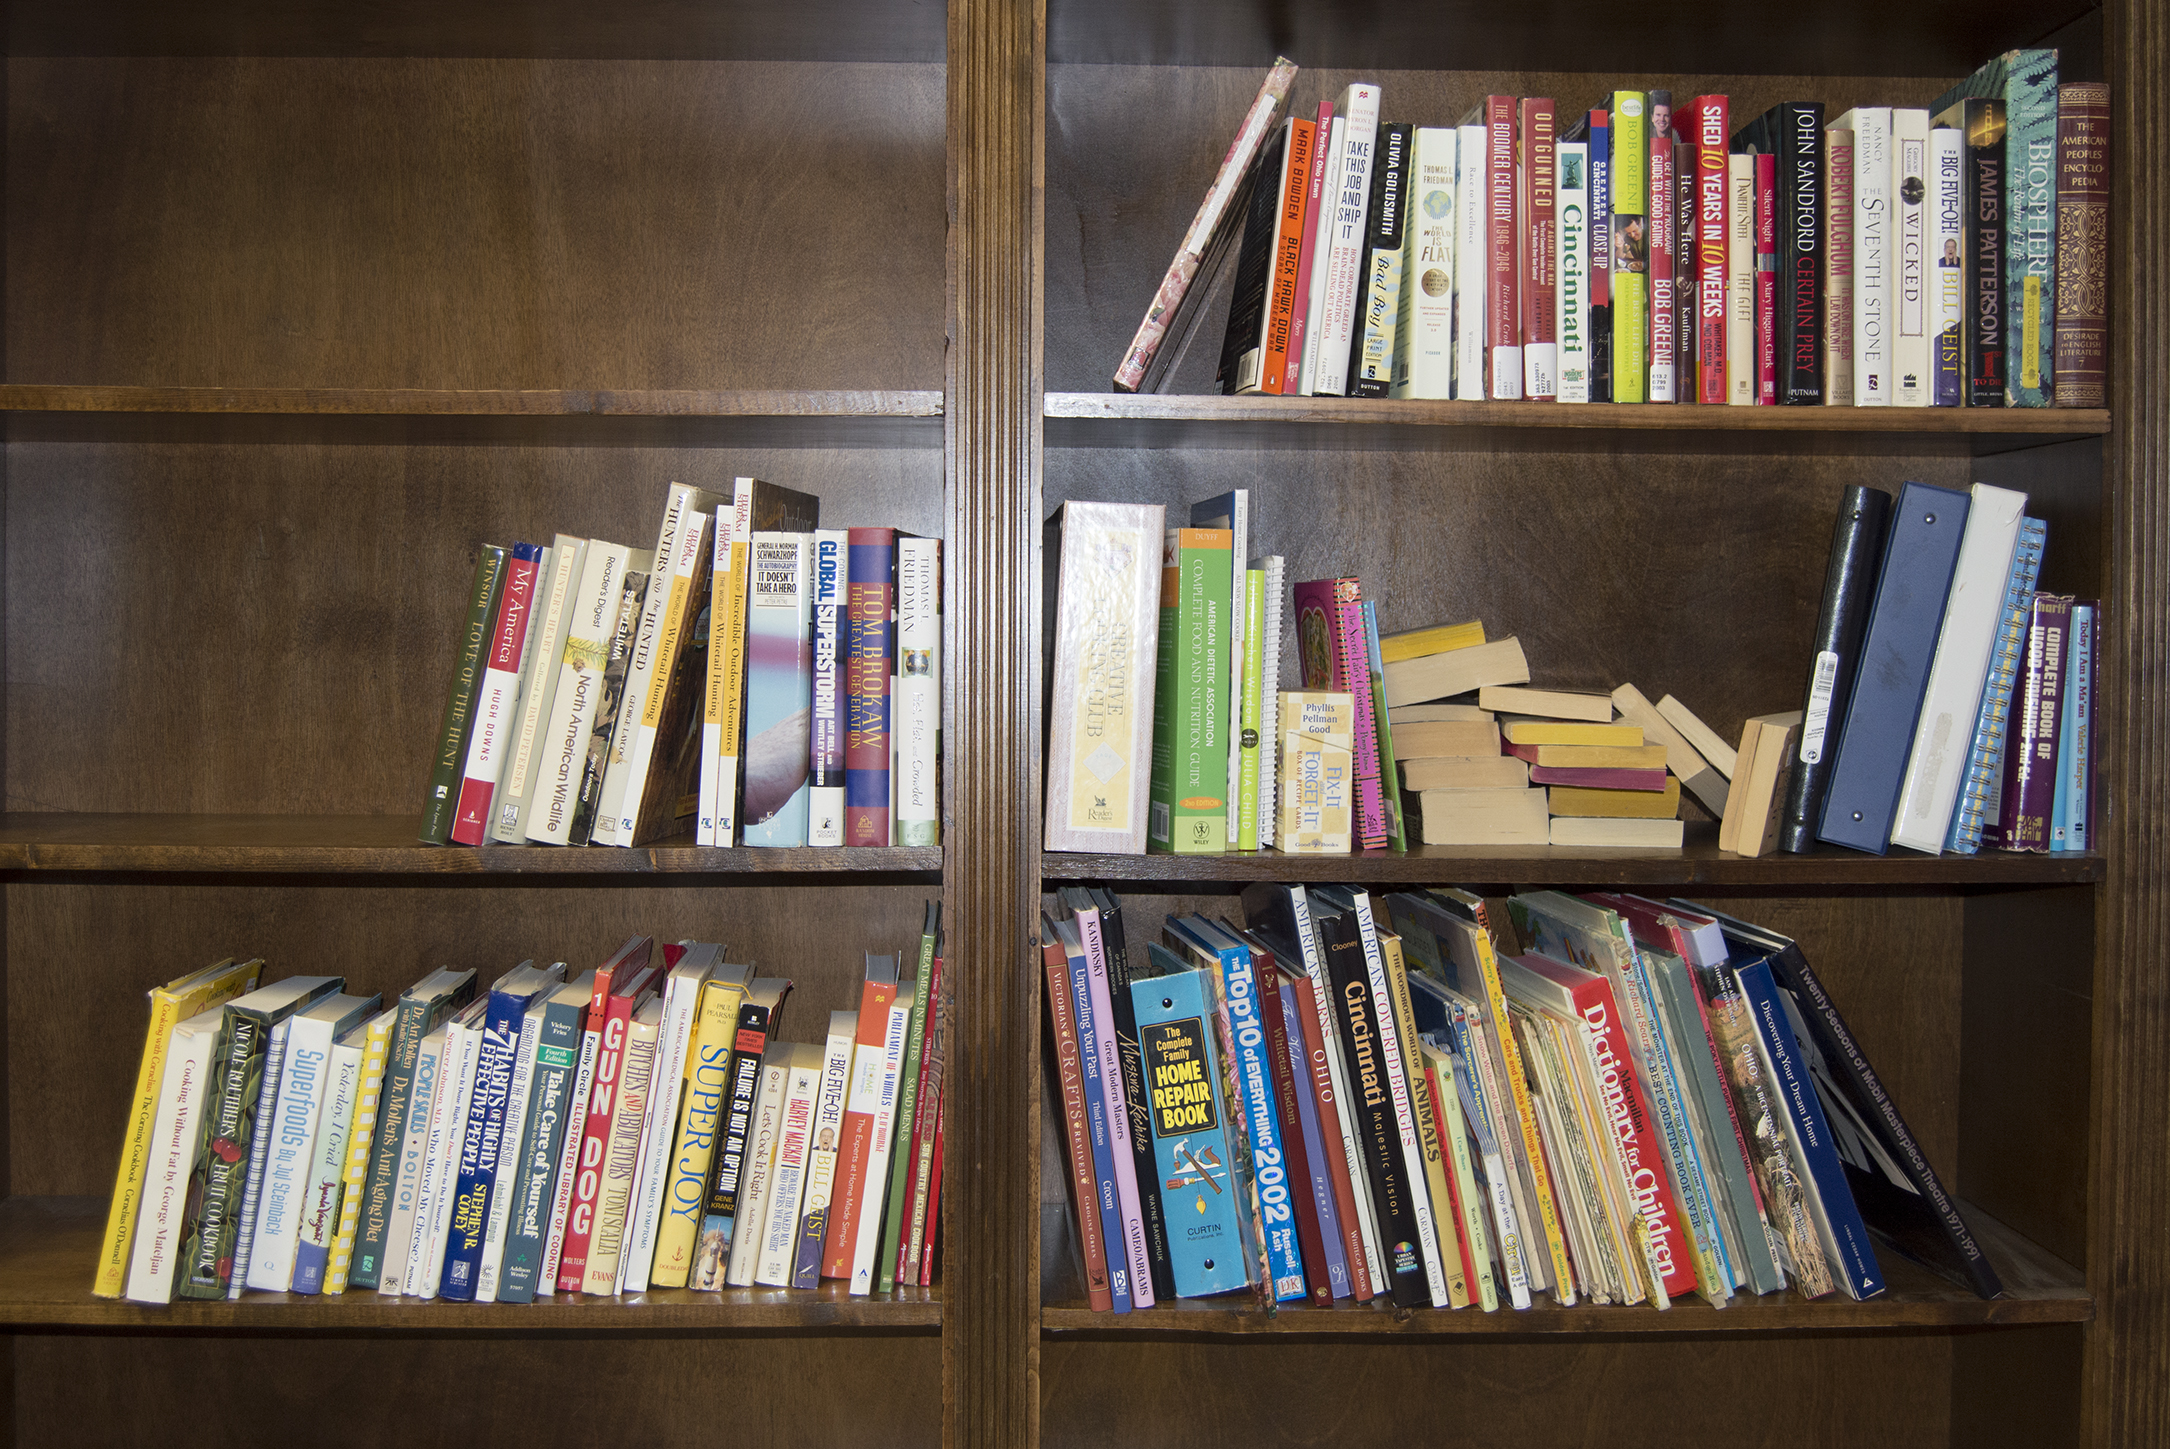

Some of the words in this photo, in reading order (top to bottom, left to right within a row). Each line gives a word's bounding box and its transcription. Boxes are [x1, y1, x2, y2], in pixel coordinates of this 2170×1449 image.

[1321, 116, 1329, 130] The
[1495, 104, 1508, 119] THE
[1703, 106, 1721, 145] SHED
[2077, 123, 2094, 131] THE
[1295, 128, 1308, 164] MARK
[1318, 131, 1328, 158] Perfect
[1346, 141, 1369, 156] TAKE
[1494, 123, 1510, 168] BOOMER
[1793, 108, 1815, 154] JOHN
[2062, 136, 2106, 145] AMERICAN
[1315, 159, 1323, 177] Ohio
[1346, 158, 1366, 174] THIS
[1388, 133, 1401, 168] OLIVIA
[1535, 113, 1552, 207] OUTGUNNED
[1701, 147, 1724, 170] 10
[2067, 150, 2102, 159] PEOPLES
[1288, 168, 1303, 220] BOWDEN
[1312, 178, 1321, 198] Lawn
[1341, 192, 1360, 206] AND
[1344, 175, 1362, 189] JOB
[1494, 173, 1511, 222] CENTURY
[1703, 173, 1722, 221] YEARS
[1977, 159, 1998, 221] JAMES
[2072, 177, 2097, 186] PEDIA
[1338, 208, 1360, 223] SHIP
[1382, 172, 1398, 235] GOLDSMITH
[1797, 160, 1815, 251] SANDFORD
[1342, 225, 1352, 239] IT
[1703, 226, 1721, 240] IN
[1284, 237, 1297, 275] BLACK
[1701, 242, 1725, 264] 10
[1905, 212, 1919, 302] WICKED
[1375, 257, 1389, 291] Bad
[1563, 204, 1583, 354] Cincinnati
[1703, 266, 1722, 318] WEEKS
[1797, 257, 1814, 327] CERTAIN
[1980, 228, 1998, 346] PATTERSON
[1279, 280, 1293, 314] HAWK
[1369, 295, 1385, 328] Boy
[1275, 319, 1288, 353] DOWN
[1797, 335, 1814, 373] PREY
[478, 559, 496, 608] WINSOR
[511, 568, 532, 595] My
[756, 583, 772, 593] TAKE
[773, 583, 778, 592] A
[779, 583, 796, 593] HERO
[758, 572, 765, 581] IT
[766, 572, 794, 582] DOESN'T
[818, 540, 837, 601] GLOBAL
[1193, 559, 1204, 619] COMPLETE
[863, 585, 883, 636] TOM
[1207, 600, 1216, 645] AMERICAN
[466, 622, 483, 662] LOVE
[499, 598, 524, 662] America
[1192, 621, 1203, 655] FOOD
[461, 668, 473, 688] OF
[816, 605, 837, 718] SUPERSTORM
[1191, 658, 1202, 684] AND
[1206, 648, 1216, 684] DIETETIC
[452, 693, 469, 722] THE
[572, 674, 591, 712] North
[862, 646, 884, 749] BROKAW
[1306, 704, 1335, 712] Phyllis
[1190, 688, 1200, 749] NUTRITION
[1206, 688, 1214, 746] ASSOCIATION
[1303, 715, 1337, 723] Pellman
[1309, 725, 1330, 734] Good
[442, 727, 461, 770] HUNT
[557, 714, 582, 782] American
[1189, 753, 1199, 787] GUIDE
[547, 783, 568, 832] Wildlife
[1087, 921, 1103, 978] KANDINSKY
[1232, 957, 1240, 971] THE
[1229, 964, 1252, 1016] Top
[484, 1028, 519, 1050] 7
[499, 1020, 509, 1035] THE
[1156, 1037, 1192, 1051] Complete
[1165, 1027, 1181, 1038] The
[1237, 1015, 1262, 1047] 10
[1357, 904, 1384, 987] AMERICAN
[1375, 992, 1400, 1070] COVERED
[1390, 1074, 1415, 1146] BRIDGES
[582, 1036, 595, 1066] Family
[1164, 1049, 1190, 1062] Family
[1243, 1048, 1259, 1061] of
[1344, 981, 1386, 1108] Cincinnati
[471, 1043, 496, 1119] EFFECTIVE
[488, 1046, 514, 1108] HABITS
[578, 1068, 590, 1096] Circle
[592, 1018, 624, 1116] GUN
[624, 1038, 655, 1091] BITCHES
[735, 1059, 756, 1098] FAILURE
[829, 1058, 846, 1076] BIG
[1155, 1060, 1202, 1087] HOME
[1583, 1001, 1637, 1149] Dictionary
[1761, 1000, 1785, 1059] Discovering
[1781, 1056, 1795, 1086] Your
[1791, 1081, 1807, 1119] Dream
[1803, 1117, 1819, 1148] Home
[281, 1049, 324, 1146] Superfoods
[545, 1070, 564, 1108] Take
[624, 1091, 642, 1111] AND
[683, 1044, 729, 1150] SUPER
[734, 1100, 750, 1111] IS
[822, 1078, 842, 1124] FIVE-OH!
[1154, 1082, 1211, 1108] REPAIR
[1246, 1063, 1273, 1148] EVERYTHING
[492, 1109, 502, 1122] OF
[538, 1110, 557, 1149] Care
[731, 1113, 747, 1135] NOT
[1162, 1103, 1209, 1129] BOOK
[1414, 1077, 1440, 1162] ANIMALS
[1799, 964, 1827, 1011] Twenty
[1826, 1009, 1857, 1060] Seasons
[1853, 1055, 1866, 1071] of
[1861, 1071, 1886, 1103] Mobil
[1880, 1102, 1925, 1171] Masterpiece
[1921, 1169, 1950, 1213] Theatre
[1946, 1210, 1981, 1261] 1971-1991
[461, 1120, 482, 1176] PEOPLE
[479, 1121, 501, 1173] HIGHLY
[565, 1102, 584, 1169] ILLUSTRATED
[608, 1108, 642, 1180] ABDICATORS
[726, 1137, 743, 1152] AN
[422, 1157, 435, 1193] Moved
[535, 1152, 550, 1170] of
[720, 1154, 740, 1192] OPTION
[813, 1153, 831, 1189] BILL
[1627, 1148, 1640, 1167] for
[211, 1164, 230, 1199] FRUIT
[557, 1173, 572, 1215] LIBRARY
[573, 1136, 603, 1235] DOG
[671, 1158, 706, 1226] JOY
[1256, 1147, 1290, 1224] 2002
[418, 1195, 429, 1213] My
[455, 1194, 471, 1233] COVEY
[467, 1183, 487, 1237] STEPHEN
[523, 1171, 548, 1239] Yourself
[807, 1194, 825, 1241] GEIST
[1633, 1168, 1675, 1277] Children
[199, 1201, 224, 1270] COOKBOOK
[412, 1216, 426, 1263] Cheese?
[464, 1238, 478, 1249] R.
[555, 1218, 563, 1232] OF
[546, 1235, 561, 1280] COOKING
[1130, 1218, 1148, 1296] CAMEO/ABRAMS
